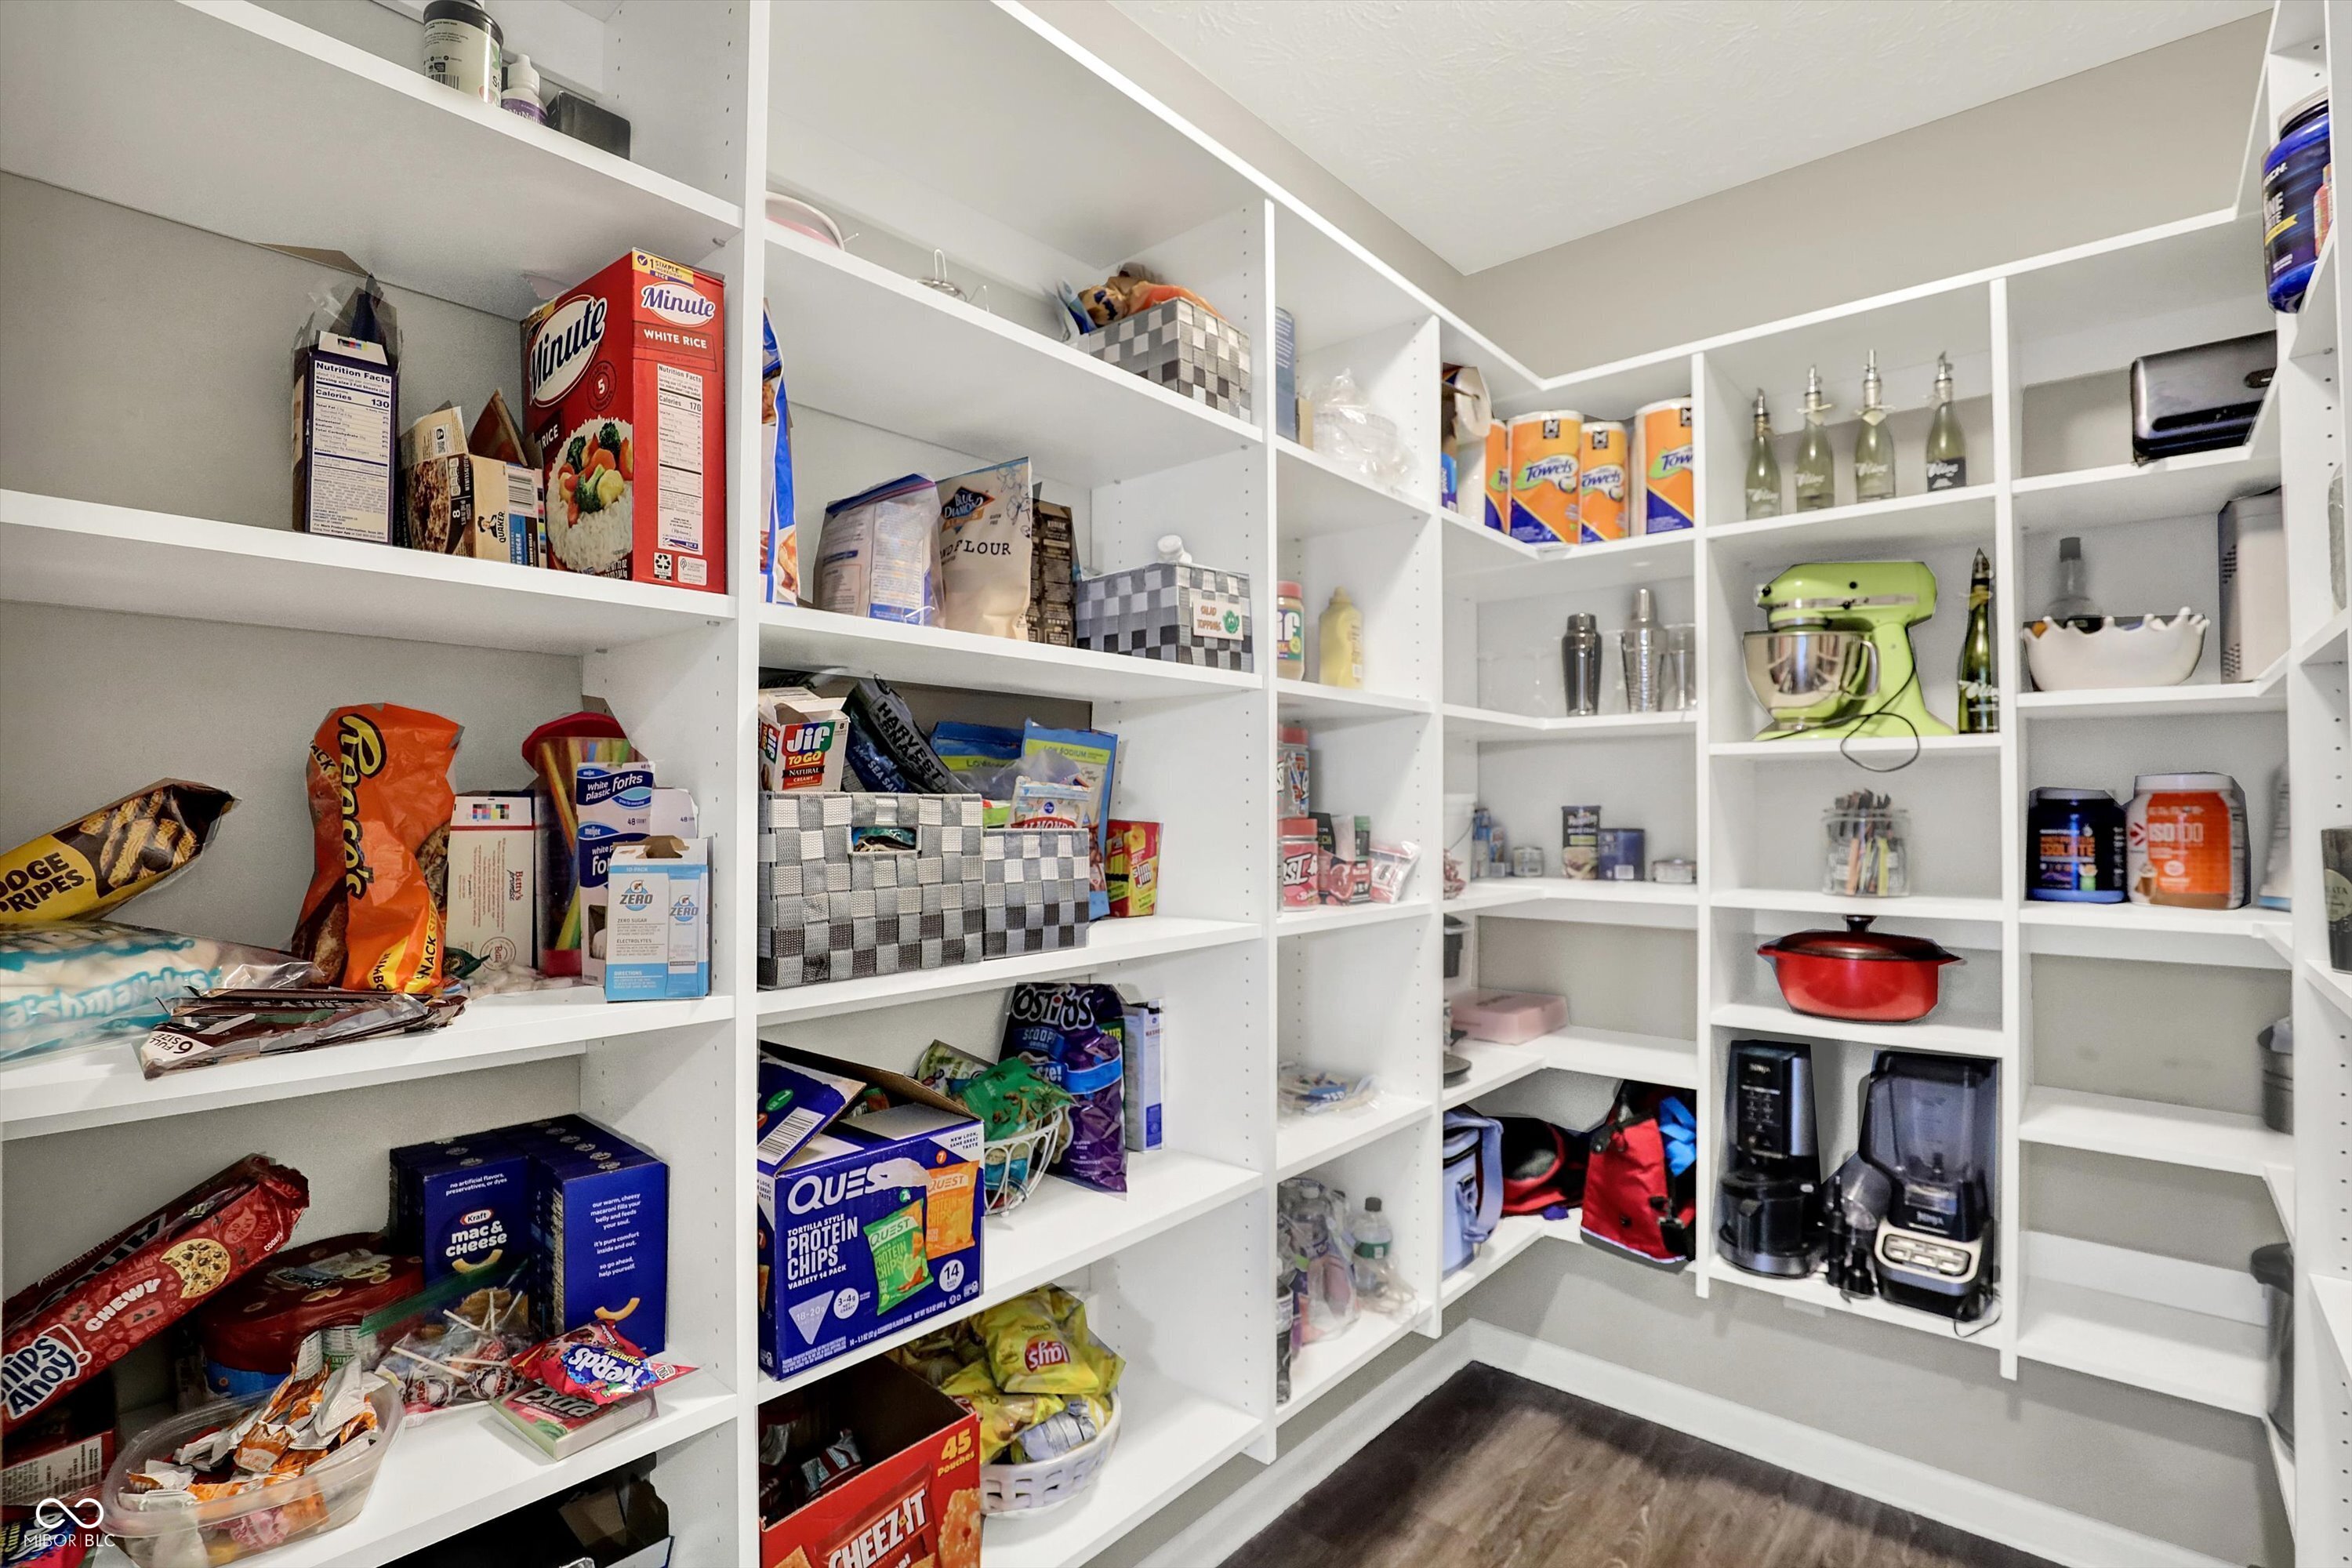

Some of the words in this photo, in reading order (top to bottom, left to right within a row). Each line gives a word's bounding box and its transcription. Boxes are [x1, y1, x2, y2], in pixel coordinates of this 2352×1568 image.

[655, 260, 679, 273] SIMPLE
[641, 285, 715, 318] Minute
[644, 328, 680, 344] WHITE
[683, 336, 707, 349] RICE
[530, 301, 606, 404] Minute
[316, 361, 361, 377] Nutrition
[364, 372, 390, 384] Facts
[659, 365, 684, 378] Nutrition
[686, 373, 702, 383] Facts
[597, 378, 605, 394] 5
[316, 389, 352, 401] Calories
[371, 399, 390, 408] 130
[659, 395, 681, 407] Calories
[690, 401, 702, 412] 170
[542, 424, 559, 449] RICE
[1526, 461, 1573, 482] Towels
[944, 496, 984, 517] DIAMOND
[954, 492, 974, 507] BLUE
[452, 510, 460, 518] 8
[954, 539, 1011, 555] FLOUR
[786, 726, 830, 753] Jif
[878, 702, 946, 779] HARVEST
[788, 756, 800, 765] TO
[803, 750, 822, 763] GO
[1059, 747, 1087, 758] SODIUM
[789, 767, 820, 777] NATURAL
[868, 760, 885, 780] SEA
[587, 780, 608, 791] white
[612, 774, 643, 792] forks
[586, 787, 611, 801] plastic
[584, 826, 601, 837] meijer
[592, 844, 608, 855] white
[515, 870, 524, 901] Betty's
[619, 894, 653, 905] ZERO
[670, 907, 699, 916] ZERO
[149, 1037, 174, 1051] FULL
[154, 1033, 182, 1045] SIZE
[173, 1040, 194, 1054] 6
[459, 1176, 483, 1186] artificial
[483, 1172, 506, 1181] flavors,
[927, 1175, 964, 1192] QUEST
[445, 1182, 486, 1196] preservatives,
[603, 1197, 621, 1206] warm,
[621, 1193, 641, 1202] cheesy
[590, 1206, 616, 1217] macaroni
[628, 1200, 641, 1210] your
[596, 1214, 609, 1224] belly
[621, 1209, 637, 1218] feeds
[467, 1213, 487, 1223] Kraft
[603, 1222, 616, 1231] your
[788, 1223, 823, 1236] TORTILLA
[824, 1213, 844, 1226] STYLE
[452, 1225, 489, 1244] mac
[491, 1220, 503, 1234] &
[603, 1237, 616, 1247] pure
[617, 1232, 640, 1243] comfort
[787, 1217, 858, 1260] PROTEIN
[870, 1218, 909, 1248] QUEST
[614, 1243, 625, 1251] and
[875, 1241, 907, 1267] PROTEIN
[612, 1263, 636, 1276] yourself.
[615, 1256, 633, 1266] ahead,
[787, 1244, 839, 1281] CHIPS
[876, 1256, 905, 1279] CHIPS
[788, 1275, 818, 1290] VARIETY
[819, 1270, 827, 1279] 14
[828, 1264, 847, 1276] PACK
[944, 1263, 960, 1280] 14
[85, 1278, 162, 1331] CHEWY
[837, 1294, 857, 1307] 3-4g
[604, 1348, 641, 1366] gummy
[1027, 1341, 1069, 1370] Lay's
[9, 1349, 77, 1415] Ahoy
[656, 1367, 669, 1380] 100
[941, 1428, 972, 1461] 45
[938, 1451, 975, 1478] Pouches
